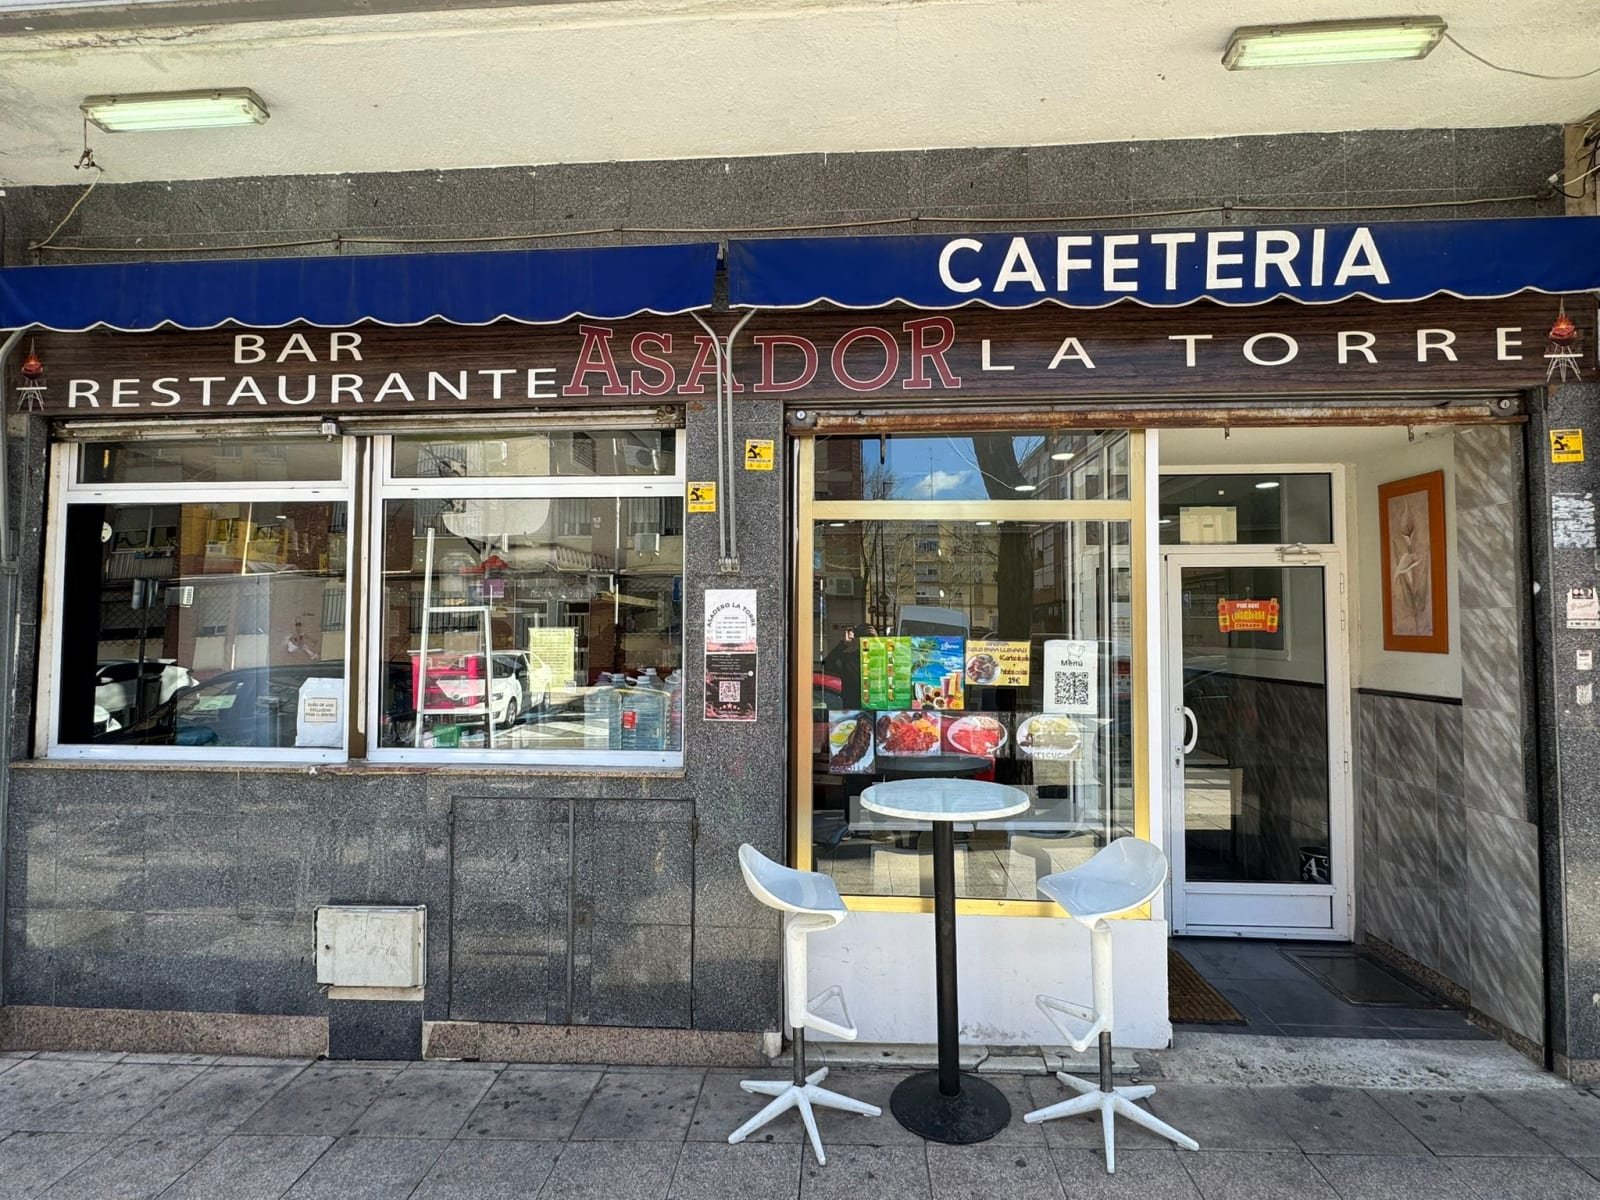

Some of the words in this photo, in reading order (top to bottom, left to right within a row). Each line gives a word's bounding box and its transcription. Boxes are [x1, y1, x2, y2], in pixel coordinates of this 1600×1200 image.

[938, 227, 1391, 293] CAFETERIA
[233, 331, 363, 365] BAR
[562, 316, 962, 398] ASADOR
[980, 336, 1096, 371] LA
[1169, 326, 1524, 367] TORRE
[67, 367, 557, 409] RESTAURANTE
